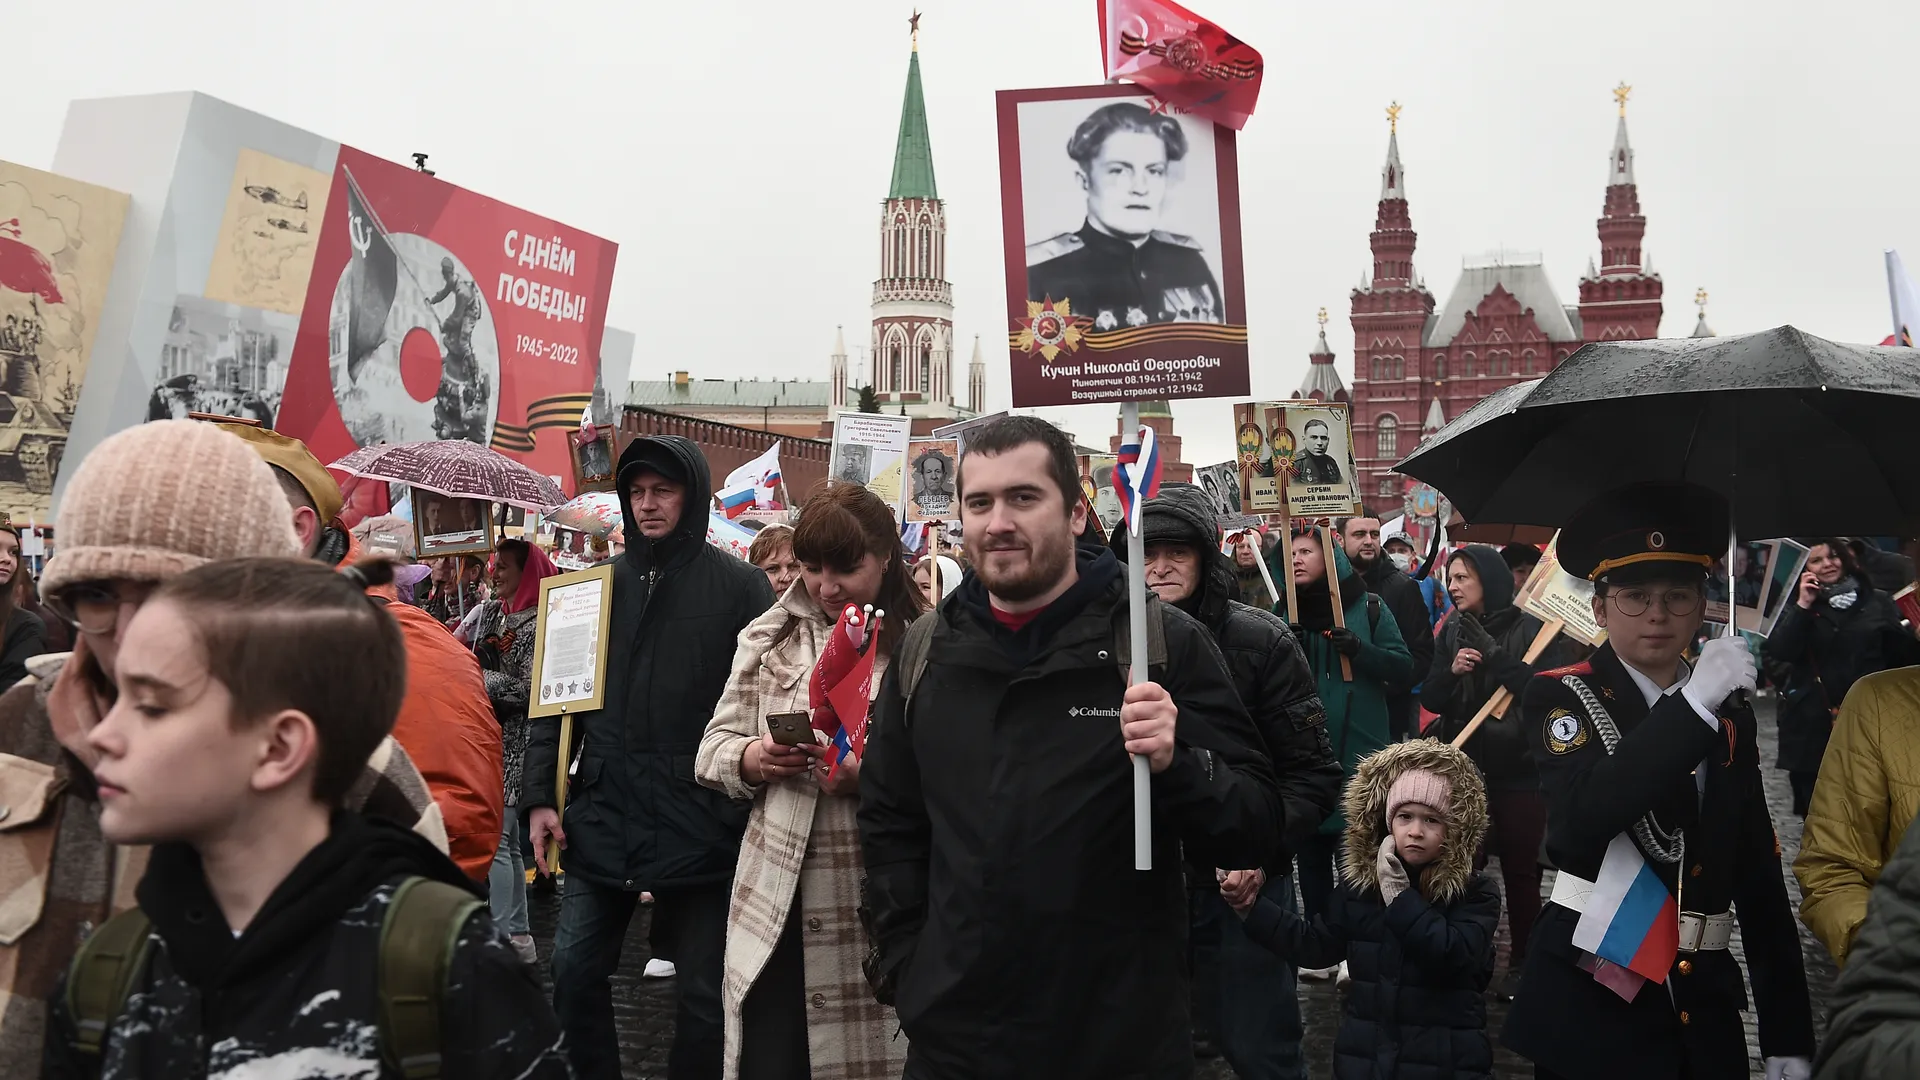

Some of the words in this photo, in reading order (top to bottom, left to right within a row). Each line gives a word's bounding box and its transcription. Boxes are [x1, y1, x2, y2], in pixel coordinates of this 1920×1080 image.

[504, 229, 519, 258] С
[518, 234, 576, 276] ДНЁМ
[497, 272, 587, 323] ПОБЕДЫ!
[1041, 362, 1081, 381] Кучин
[1084, 358, 1141, 376] Николай
[1144, 354, 1221, 375] Федорович
[1072, 377, 1123, 388] Минометчик
[1124, 371, 1203, 385] 08.1941-12.1942
[1071, 388, 1122, 401] Воздушный
[1123, 386, 1159, 398] стрелок
[1159, 387, 1165, 395] с
[1166, 383, 1204, 395] 12.1942
[1291, 494, 1316, 503] АНДРЕЙ
[1306, 486, 1332, 494] СЕРБИН
[1079, 707, 1120, 717] Columbi
